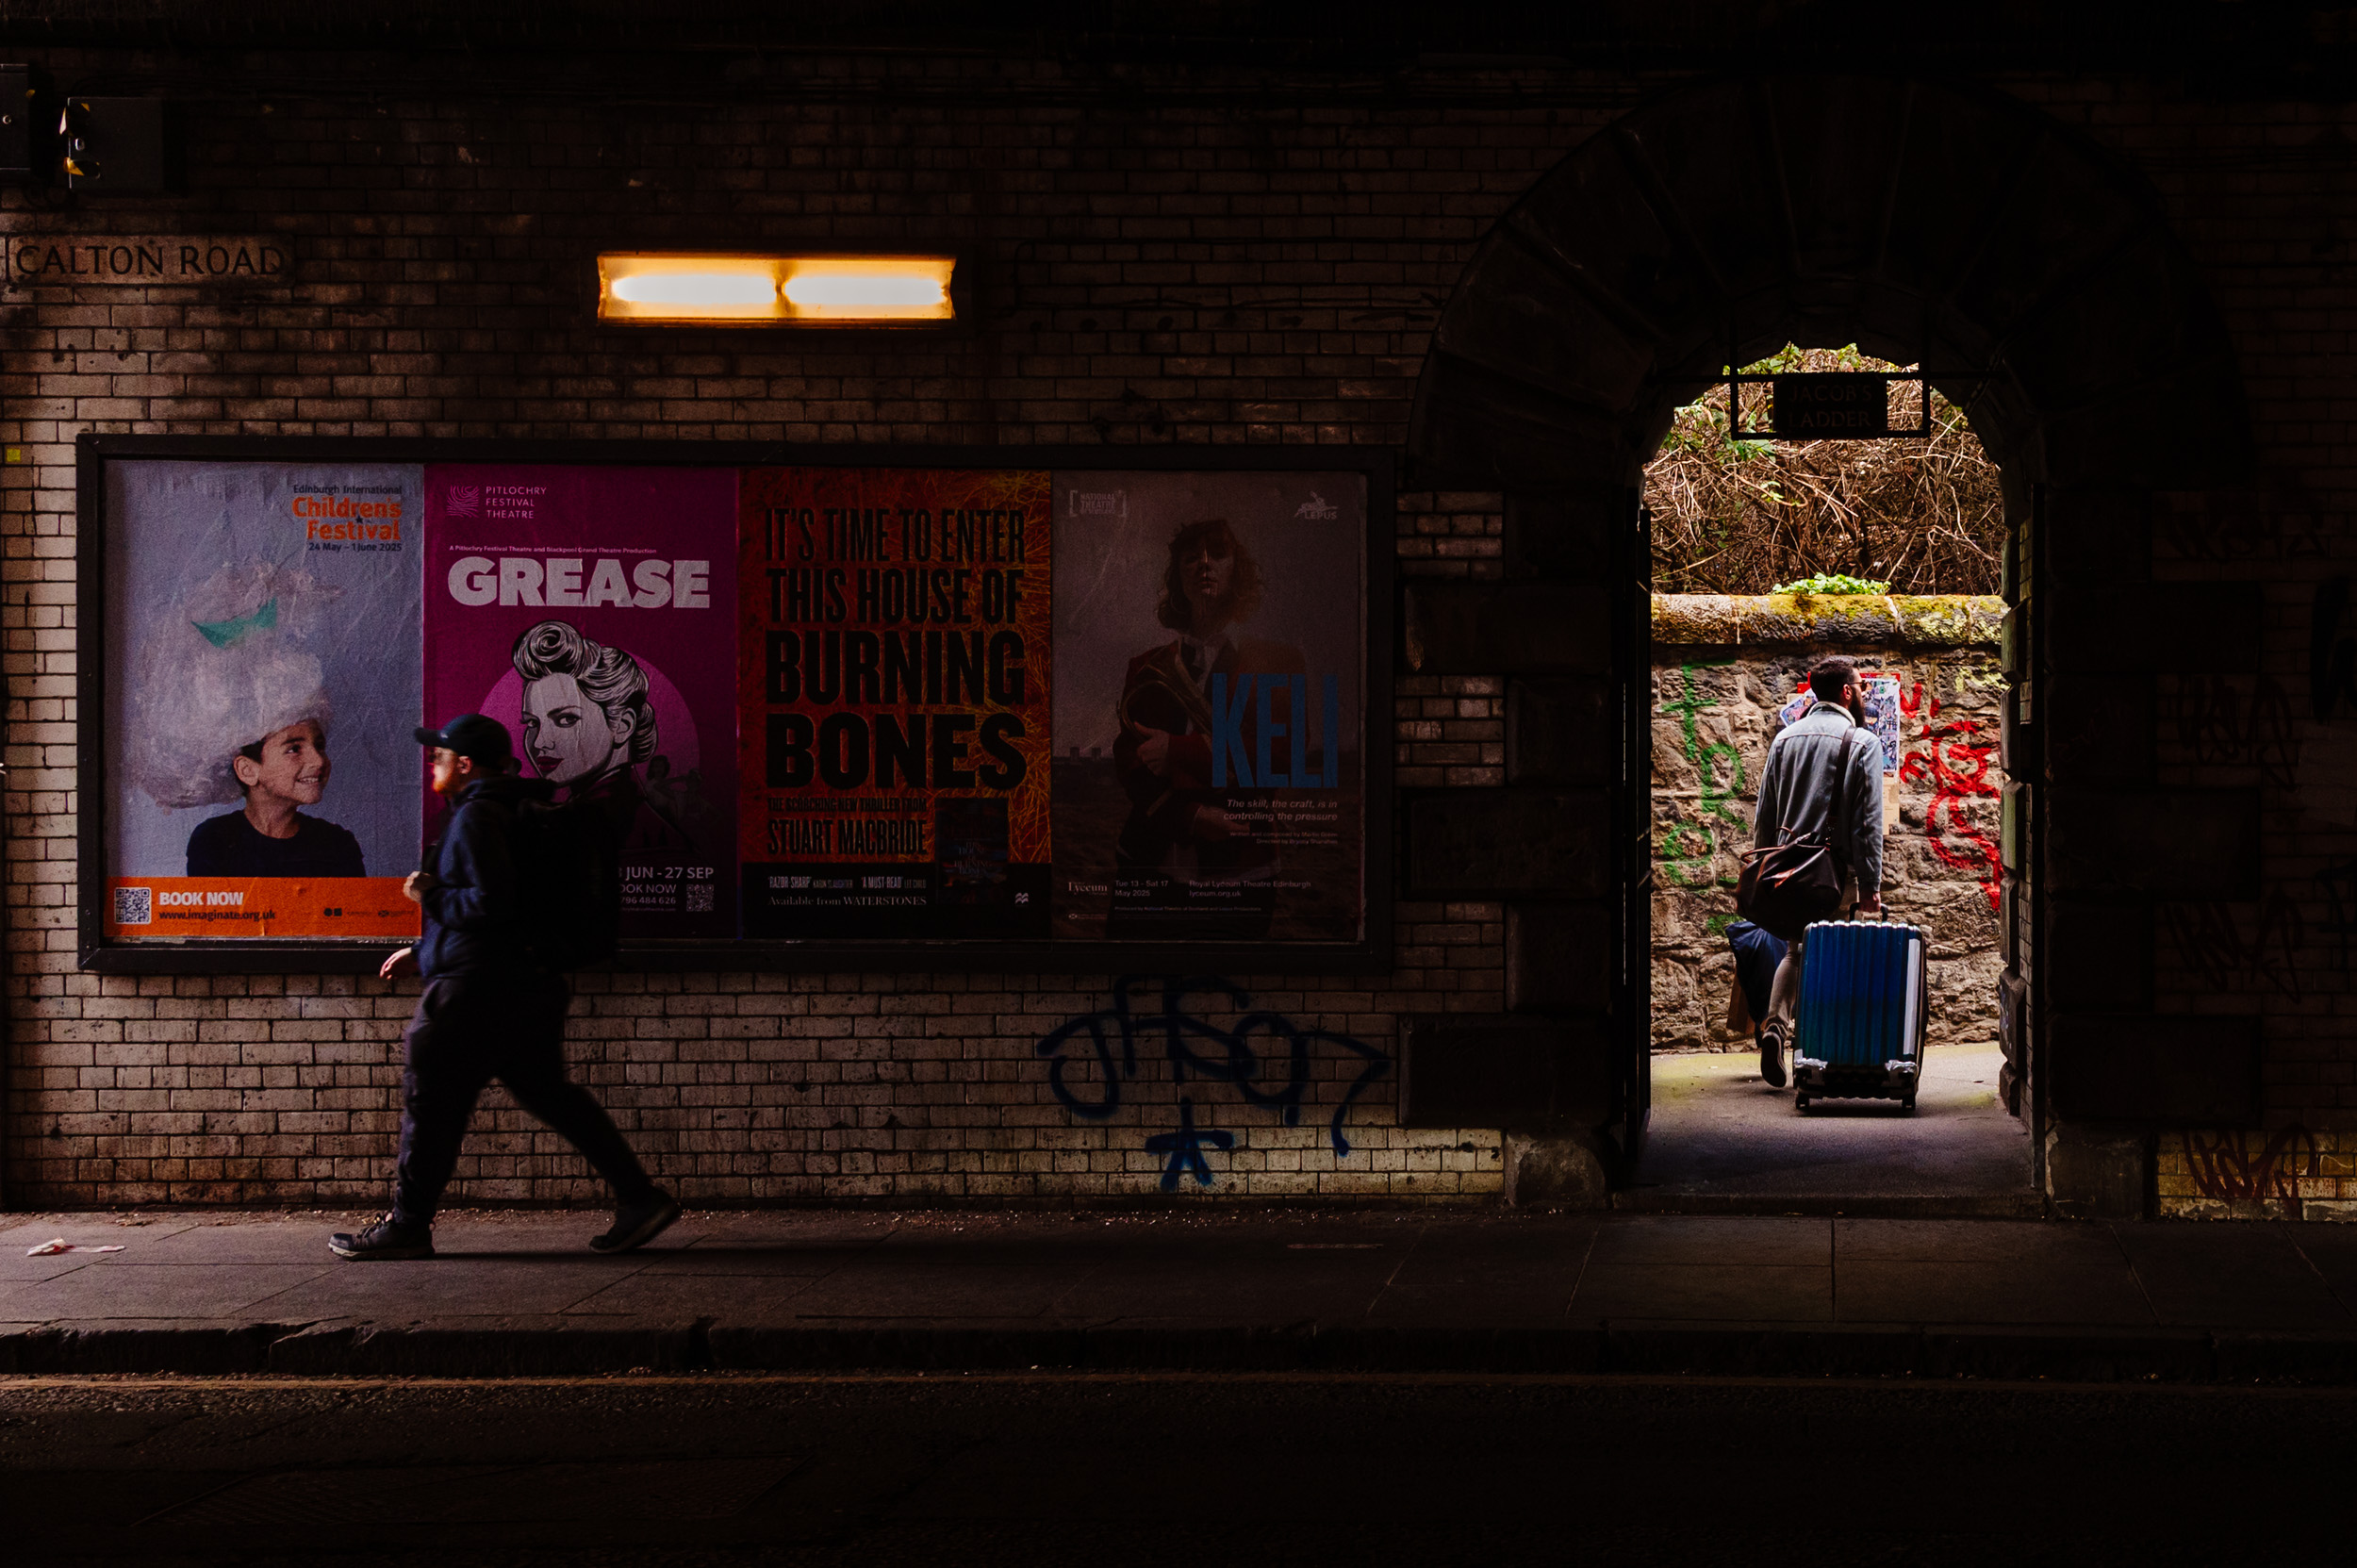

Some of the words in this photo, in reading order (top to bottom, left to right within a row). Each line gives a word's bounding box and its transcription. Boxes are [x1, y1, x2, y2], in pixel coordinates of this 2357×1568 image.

[16, 245, 164, 275] CALTON
[179, 245, 283, 275] ROAD
[1788, 384, 1872, 402] JACOB'S
[1788, 410, 1871, 428] LADDER
[293, 485, 339, 495] Edinburgh
[343, 485, 403, 495] International
[486, 486, 547, 496] PITLOCHRY
[292, 496, 403, 518] Children's
[486, 497, 536, 507] FESTIVAL
[486, 509, 535, 520] THEATRE
[1304, 511, 1338, 520] LEPUS
[307, 520, 401, 540] Festival
[766, 507, 815, 561] IT'S
[823, 508, 891, 562] TIME
[898, 508, 931, 562] TO
[943, 508, 1026, 563] ENTER
[308, 543, 321, 552] 24
[322, 543, 341, 553] May
[379, 543, 403, 552] 2025
[448, 555, 710, 609] GREASE
[766, 568, 848, 624] THIS
[857, 568, 973, 624] HOUSE
[982, 568, 1025, 624] OF
[766, 629, 1026, 705] BURNING
[1211, 672, 1339, 788] KELI
[766, 712, 1028, 790] BONES
[1227, 800, 1244, 808] The
[1246, 799, 1268, 809] skill,
[1272, 800, 1288, 808] the
[1290, 799, 1315, 809] craft,
[1317, 800, 1326, 808] is
[1328, 800, 1338, 808] in
[1224, 812, 1275, 822] controlling
[1277, 812, 1294, 820] the
[1294, 814, 1338, 822] pressure
[768, 819, 833, 854] STUART
[838, 819, 928, 855] MACBRIDE
[624, 867, 654, 882] JUN
[664, 867, 684, 879] 27
[686, 867, 715, 879] SEP
[618, 883, 643, 894] OOK
[646, 883, 677, 894] NOW
[1068, 882, 1108, 894] Lyceum
[1189, 880, 1211, 888] Royal
[1211, 880, 1241, 888] Lyceum
[1273, 880, 1311, 889] Edinburgh
[158, 891, 205, 906] BOOK
[206, 891, 244, 906] NOW
[1114, 889, 1131, 898] May
[767, 896, 815, 906] Available
[816, 896, 841, 906] from
[843, 896, 928, 906] WATERSTONES
[158, 908, 275, 922] www.imaginate.org.uk
